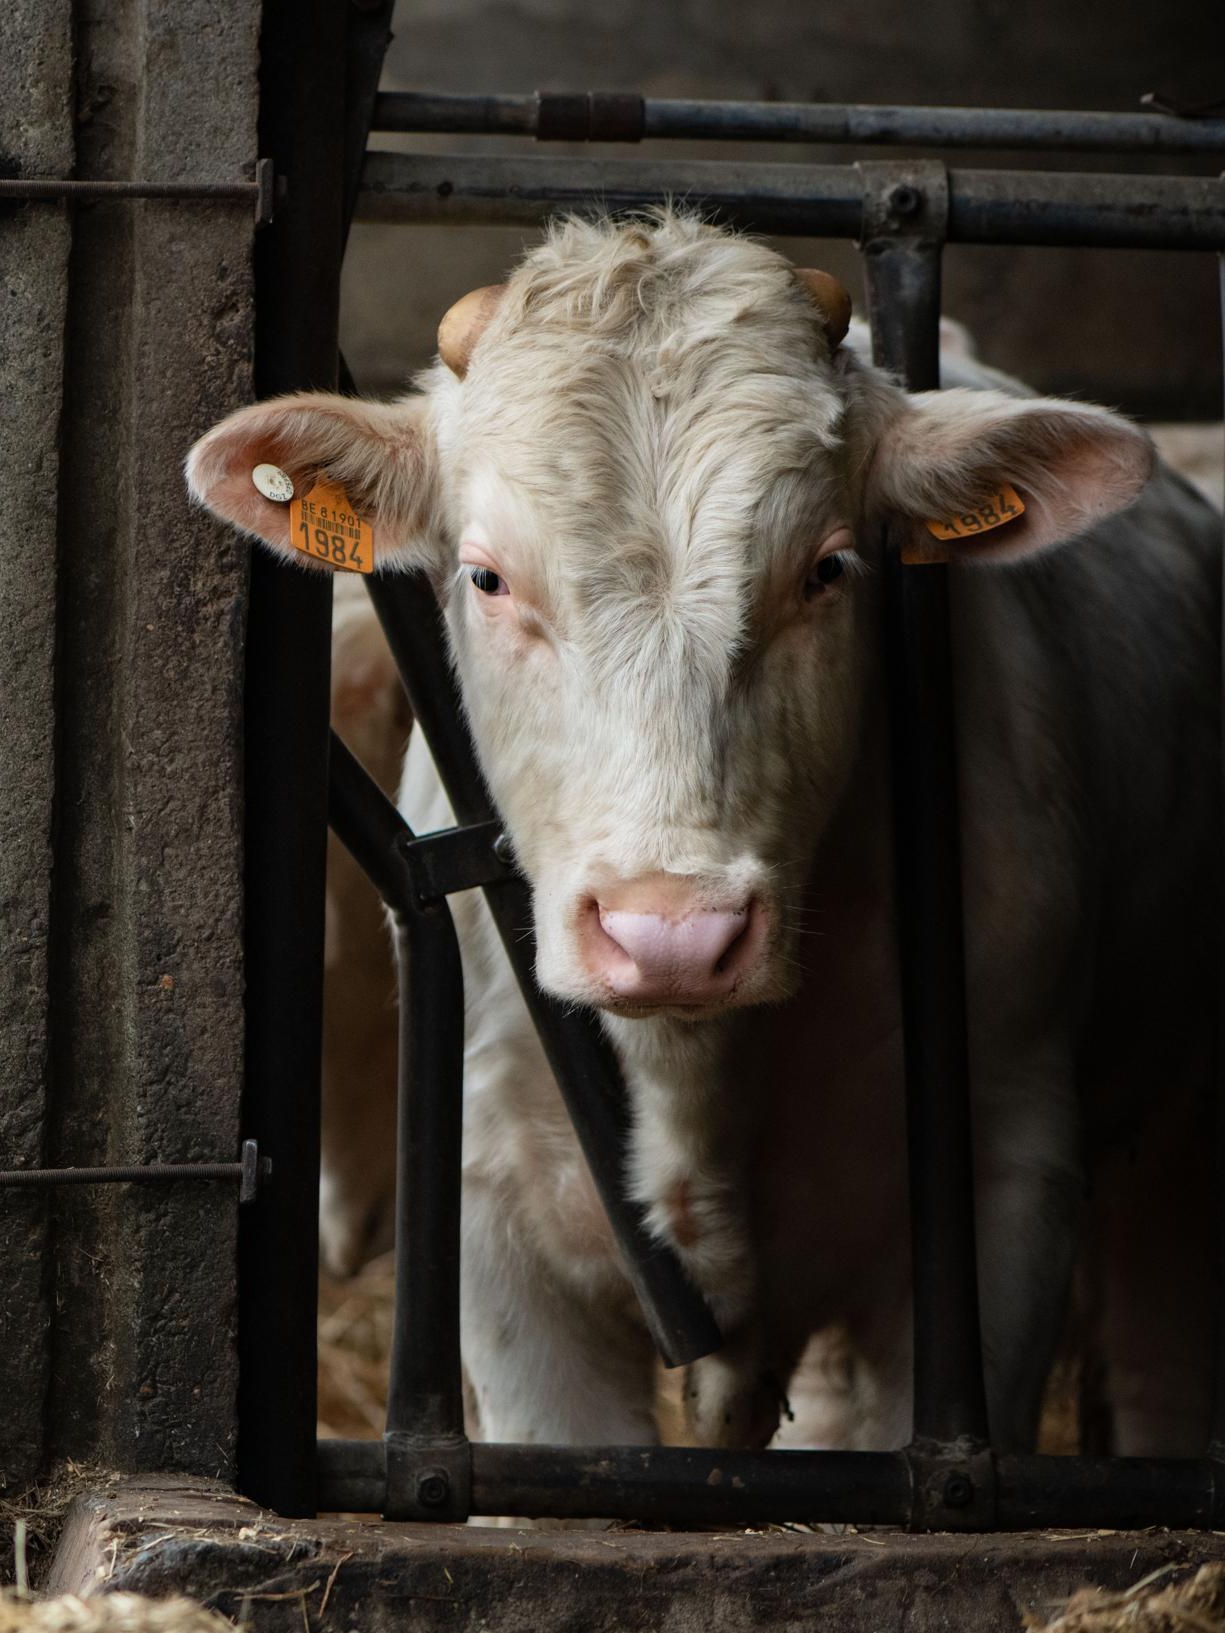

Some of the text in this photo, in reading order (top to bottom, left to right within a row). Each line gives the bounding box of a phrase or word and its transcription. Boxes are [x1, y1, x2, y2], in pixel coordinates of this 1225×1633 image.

[301, 499, 317, 515] BE
[944, 494, 1017, 535] 1984
[299, 521, 364, 570] 1984
